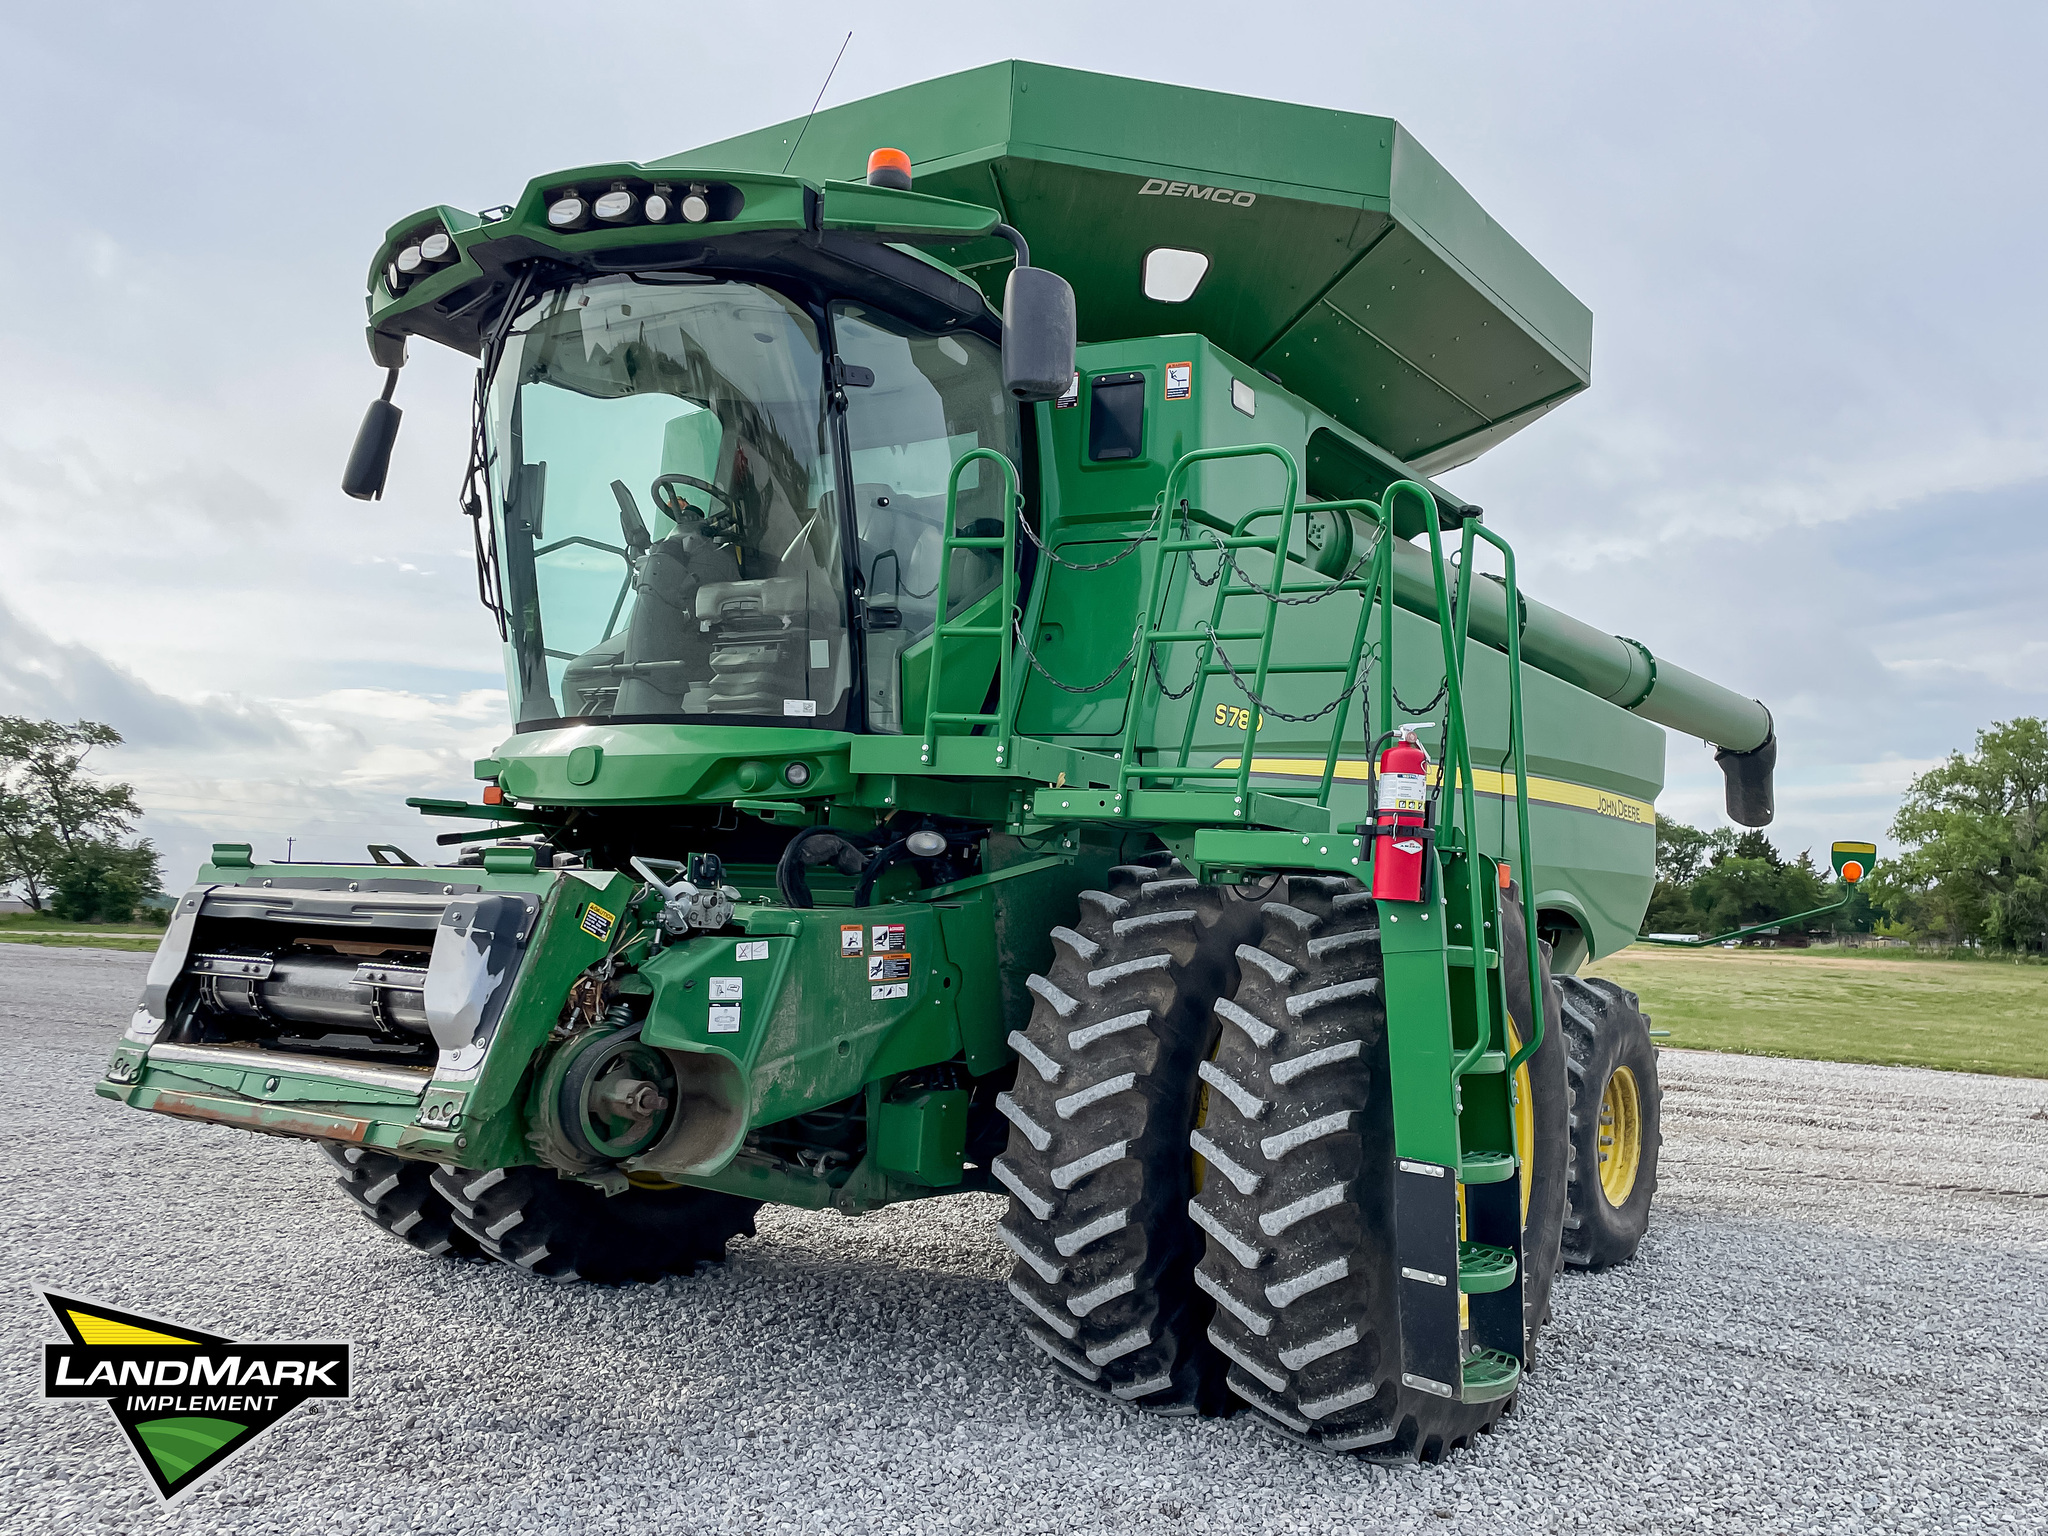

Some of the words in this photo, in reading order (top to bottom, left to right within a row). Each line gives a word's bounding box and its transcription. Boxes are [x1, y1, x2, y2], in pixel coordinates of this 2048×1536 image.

[1138, 178, 1257, 207] DEMCO
[1597, 793, 1617, 815] JOHN
[1617, 799, 1641, 821] DEERE
